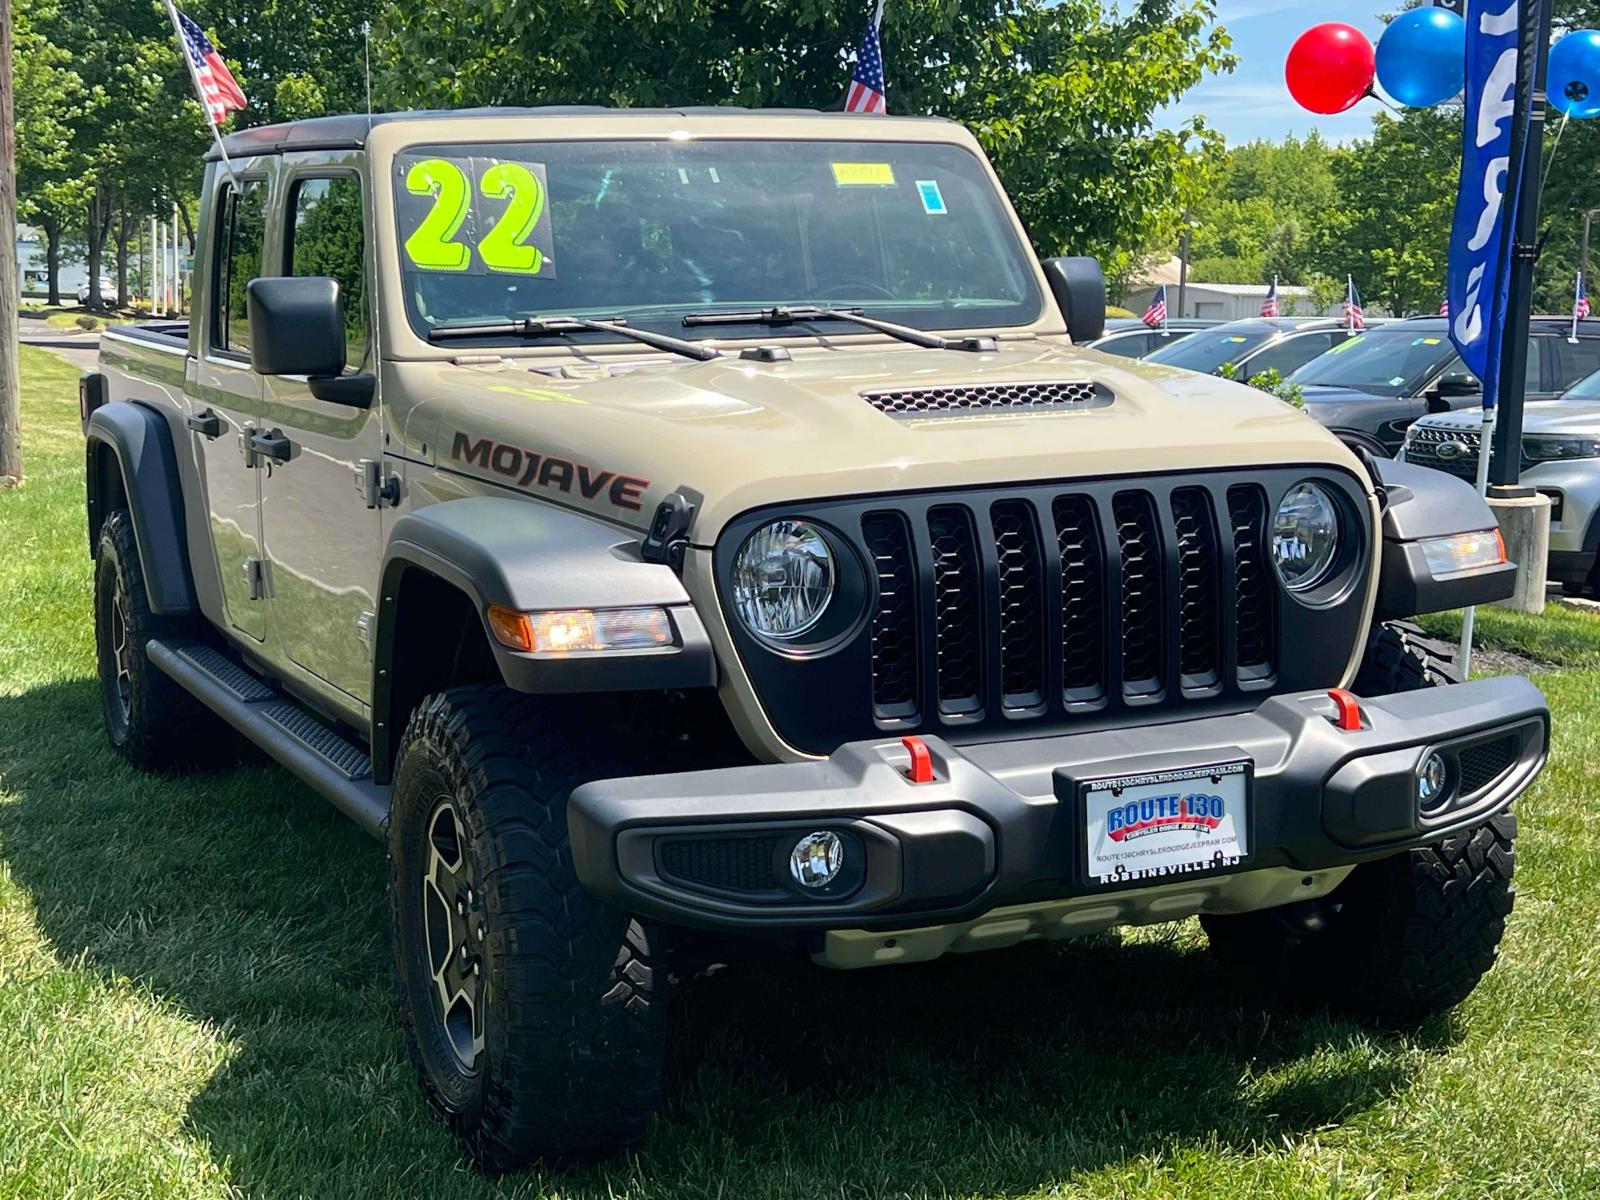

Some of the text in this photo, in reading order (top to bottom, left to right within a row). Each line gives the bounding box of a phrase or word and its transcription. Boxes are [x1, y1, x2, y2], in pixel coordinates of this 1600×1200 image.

[404, 159, 545, 274] 22
[451, 430, 651, 512] MOJAVE
[1108, 793, 1225, 833] ROUTE 130
[1126, 827, 1159, 840] CHRYSLER
[1159, 824, 1179, 833] DODGE
[1180, 823, 1195, 831] JEEP
[1100, 855, 1240, 884] ROBBINSVILLE, NJ
